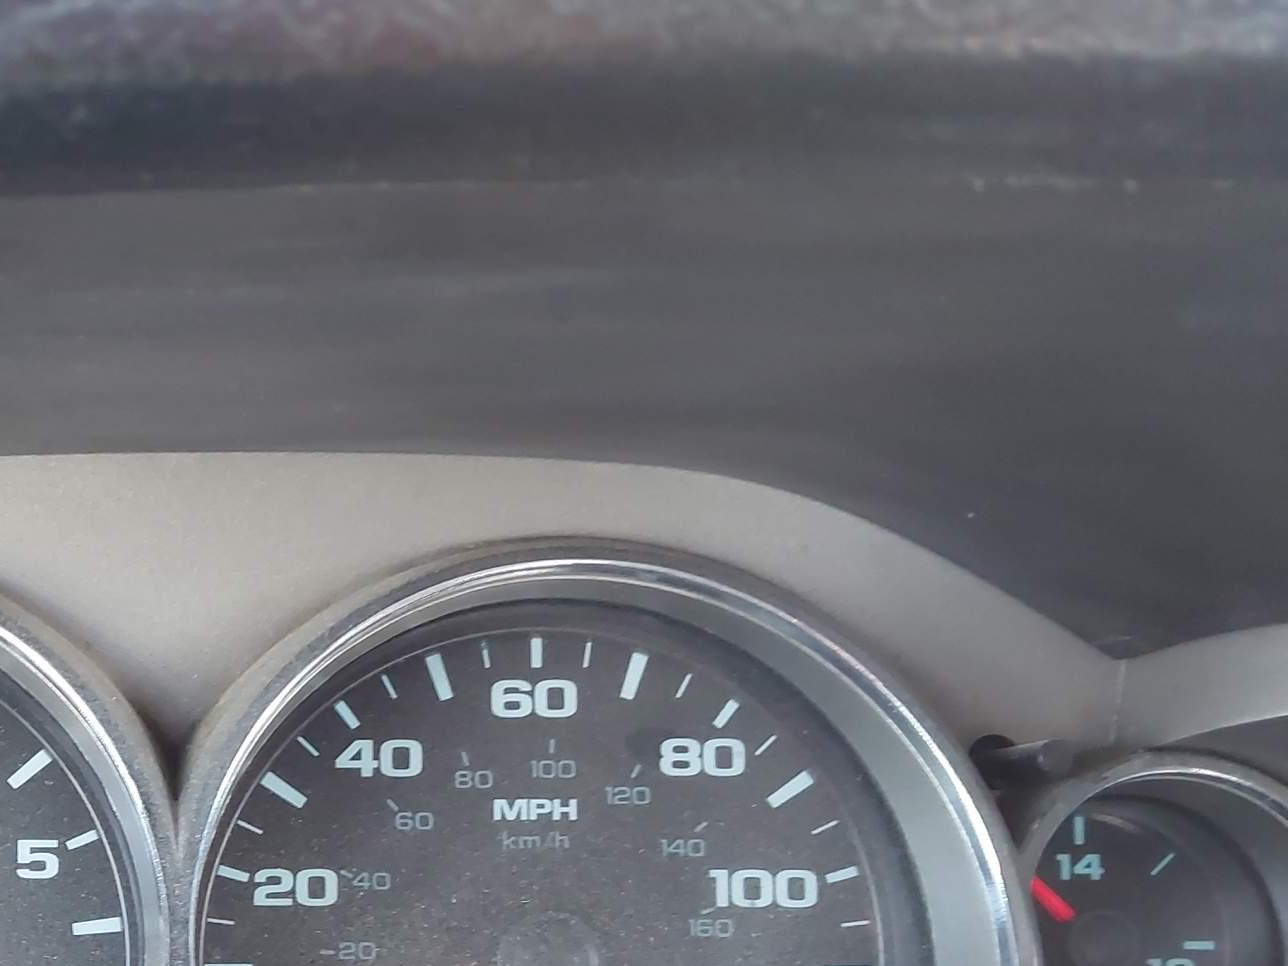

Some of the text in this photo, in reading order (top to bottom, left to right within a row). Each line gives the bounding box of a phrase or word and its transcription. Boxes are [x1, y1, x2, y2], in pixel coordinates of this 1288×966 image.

[490, 679, 577, 718] 60
[334, 738, 424, 777] 40
[659, 738, 745, 777] 80
[454, 769, 494, 790] 80
[530, 760, 577, 779] 100
[604, 786, 651, 806] 120
[492, 798, 578, 821] MPH
[394, 811, 435, 832] 60
[500, 831, 570, 850] km/h
[660, 838, 706, 858] 140
[14, 839, 59, 880] 5
[1055, 853, 1104, 881] 14
[252, 868, 340, 907] 20
[351, 871, 392, 890] 40
[708, 869, 818, 908] 100
[688, 918, 733, 938] 160
[338, 941, 377, 961] 20
